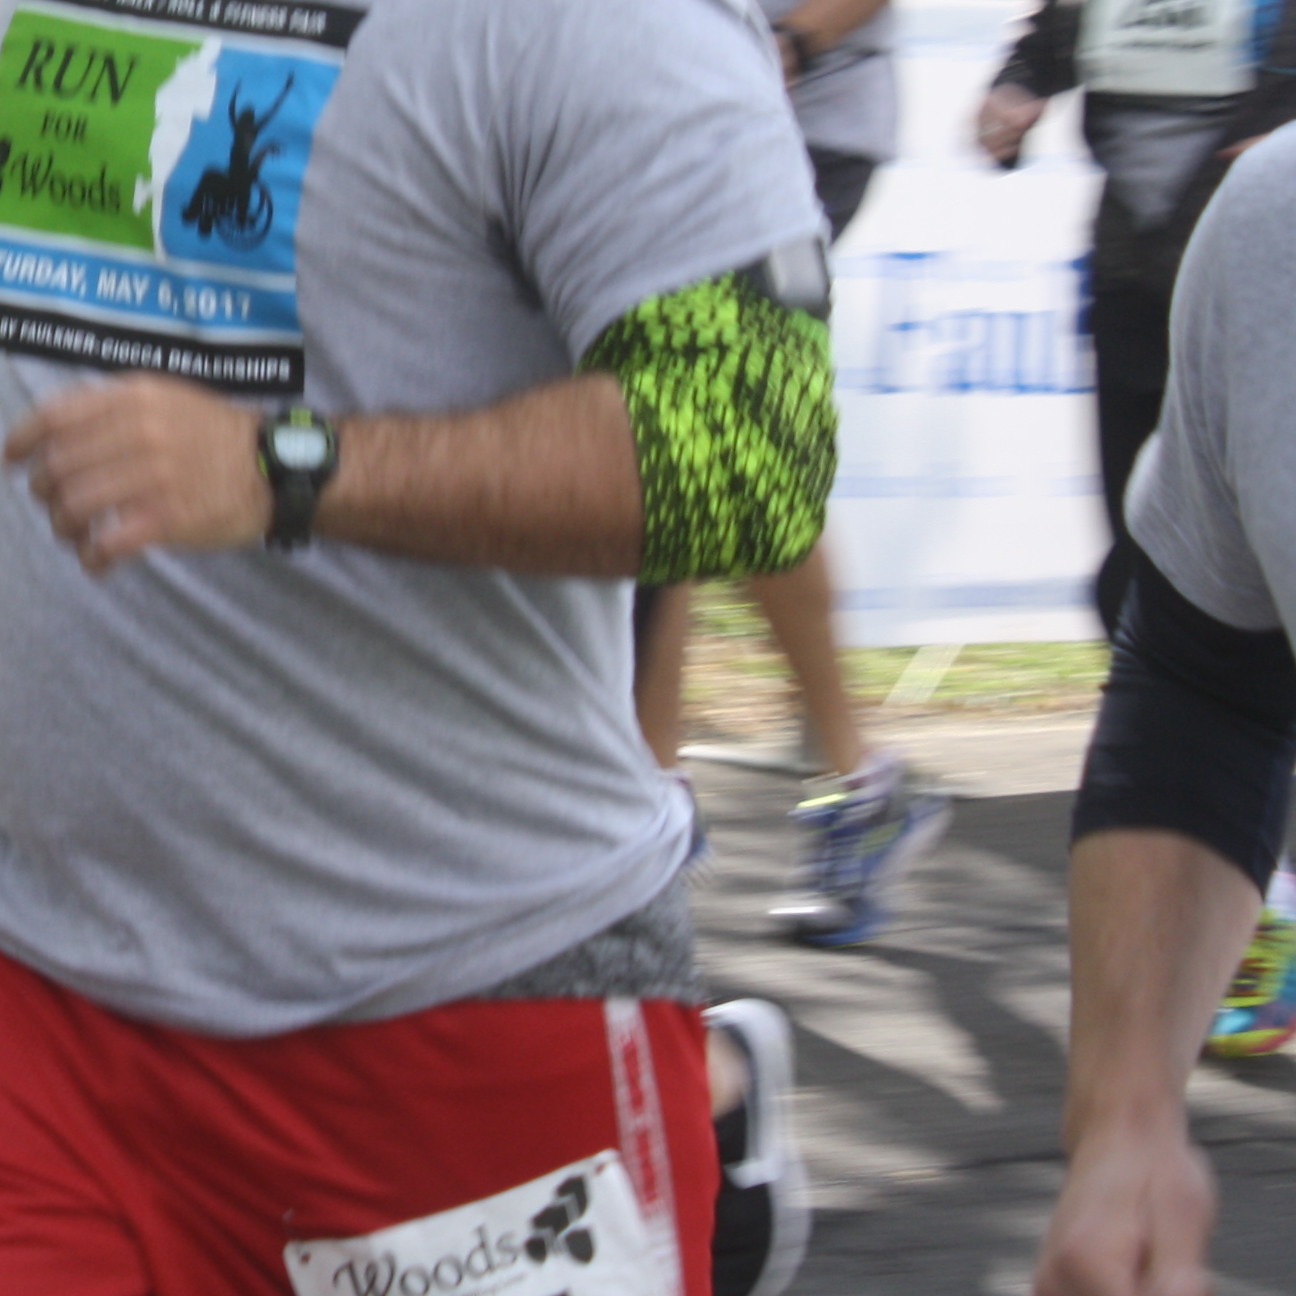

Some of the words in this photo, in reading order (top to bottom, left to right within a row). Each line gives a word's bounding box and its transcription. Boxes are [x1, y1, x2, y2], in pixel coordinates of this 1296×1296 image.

[223, 0, 287, 32] FITNESS
[289, 7, 327, 37] FAIR
[17, 39, 138, 107] RUN
[39, 109, 89, 144] FOR
[10, 151, 123, 218] Woods
[96, 267, 151, 306] MAY
[183, 285, 251, 322] 2017
[168, 345, 291, 384] DEALERSHIPS
[332, 1223, 520, 1296] Woods
